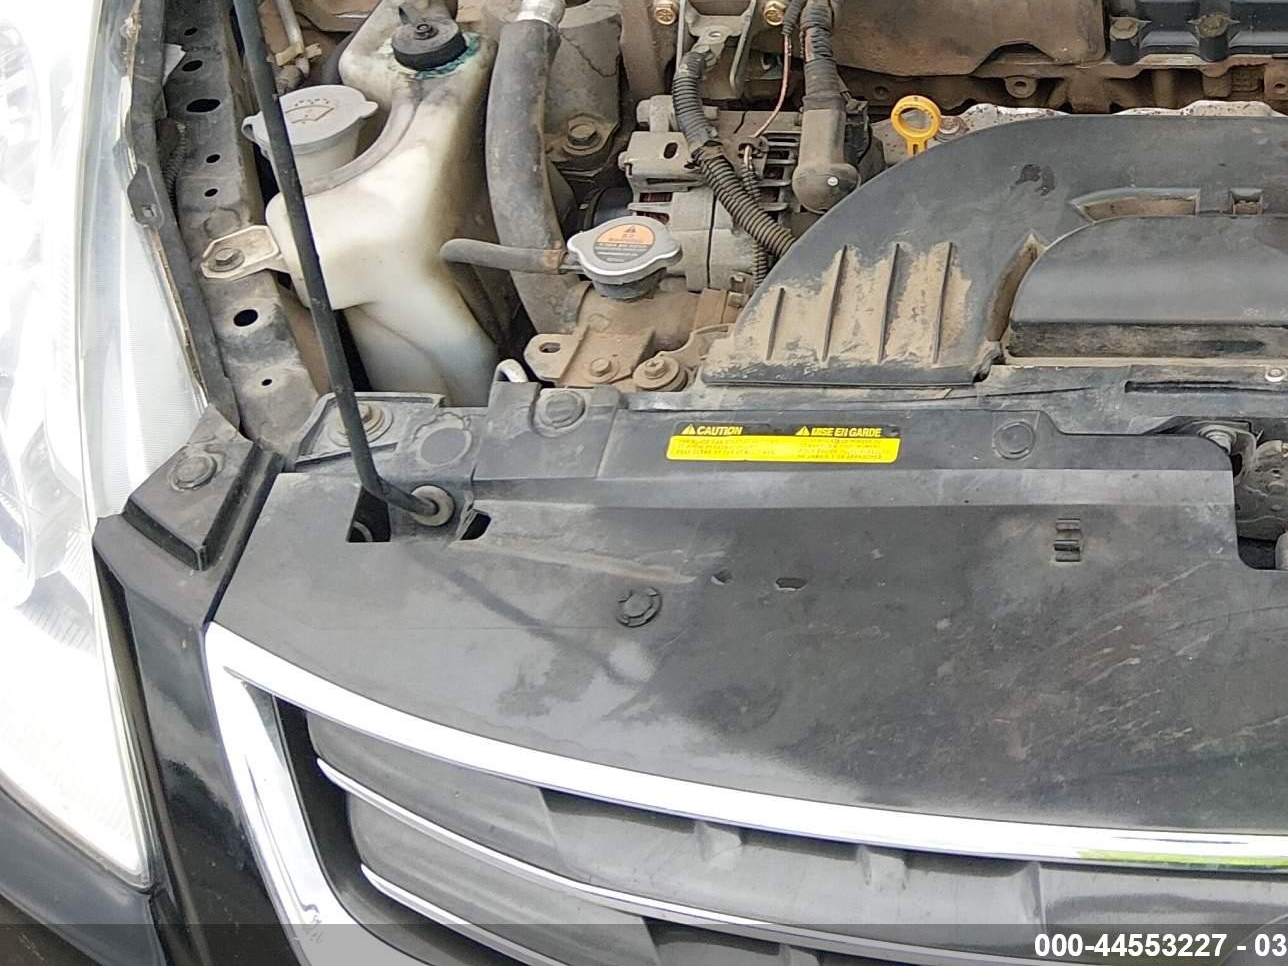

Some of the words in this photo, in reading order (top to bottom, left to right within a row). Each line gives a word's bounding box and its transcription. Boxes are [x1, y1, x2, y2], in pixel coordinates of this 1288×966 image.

[696, 425, 744, 435] CAUTION
[834, 427, 848, 437] EN
[849, 427, 882, 437] GARDE
